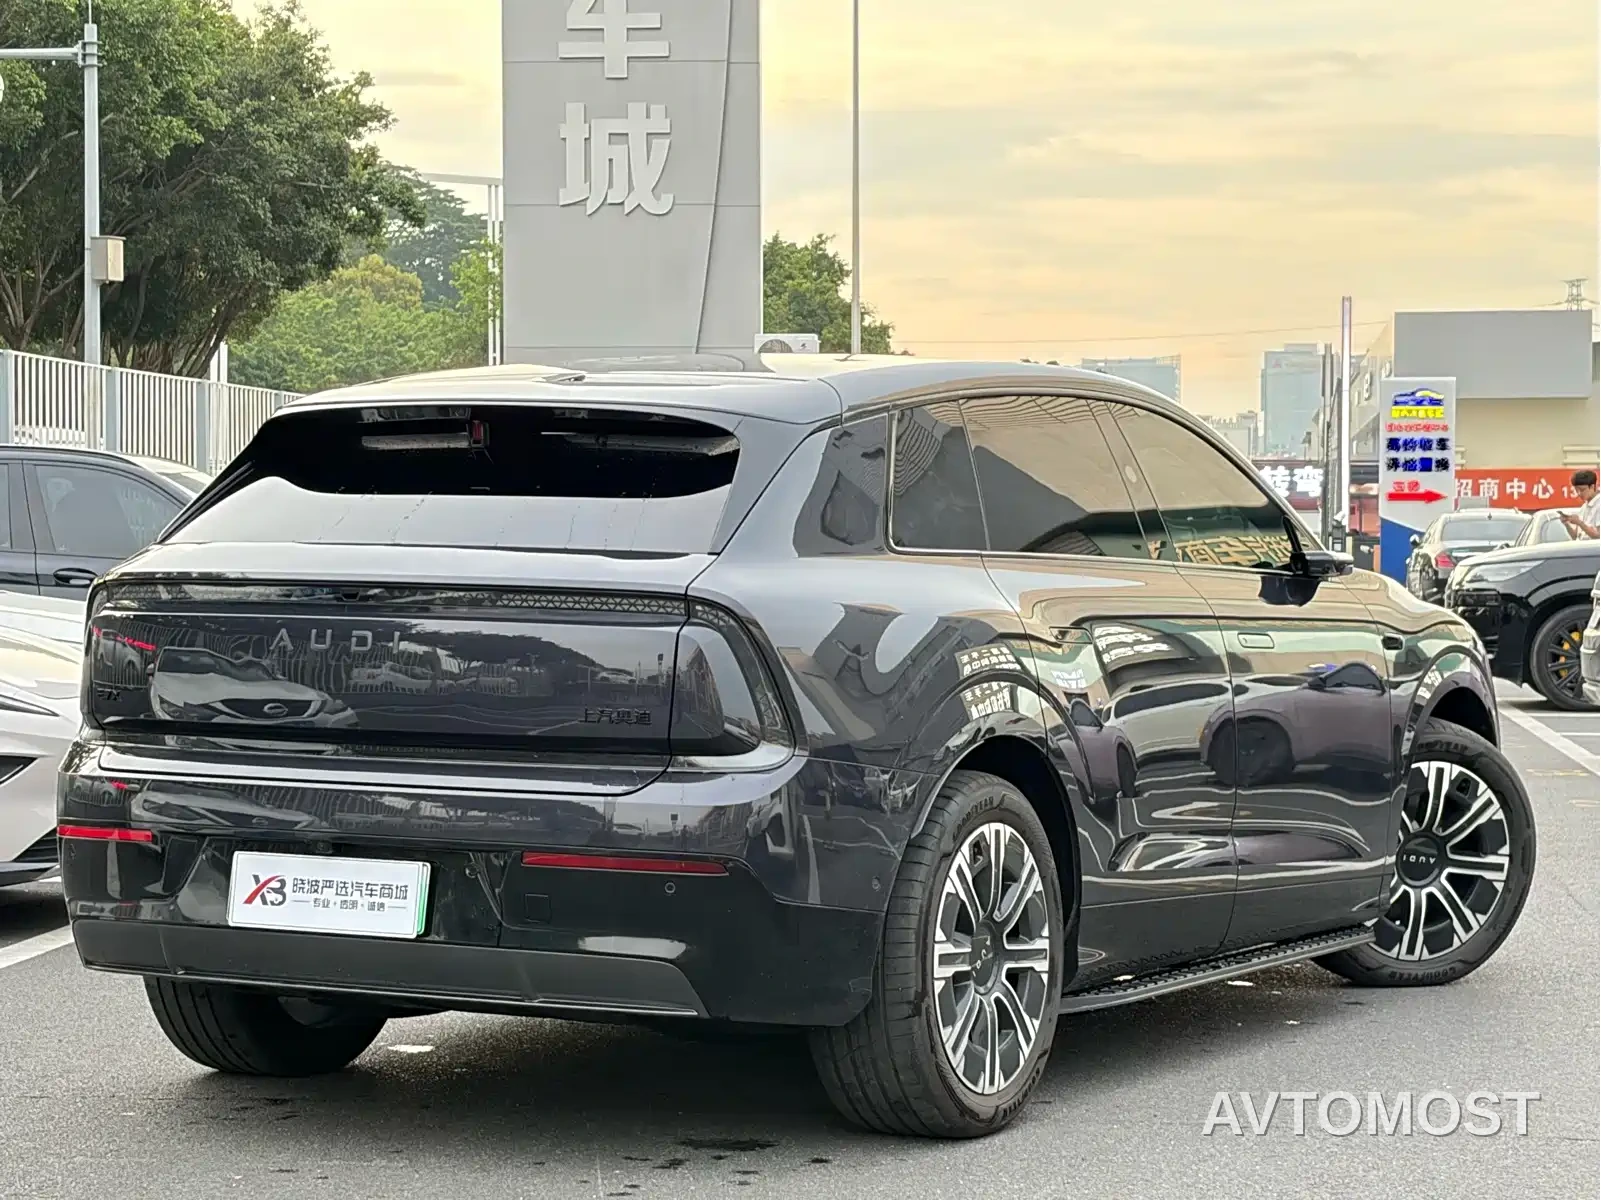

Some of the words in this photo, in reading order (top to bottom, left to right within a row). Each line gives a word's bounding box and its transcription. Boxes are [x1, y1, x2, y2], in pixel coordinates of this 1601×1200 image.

[1455, 478, 1555, 500] 招商中心
[269, 627, 401, 654] AUDI
[578, 705, 653, 726] 上汽奥迪
[1403, 853, 1438, 864] AUDI
[292, 877, 409, 901] 晓波严选汽车商城
